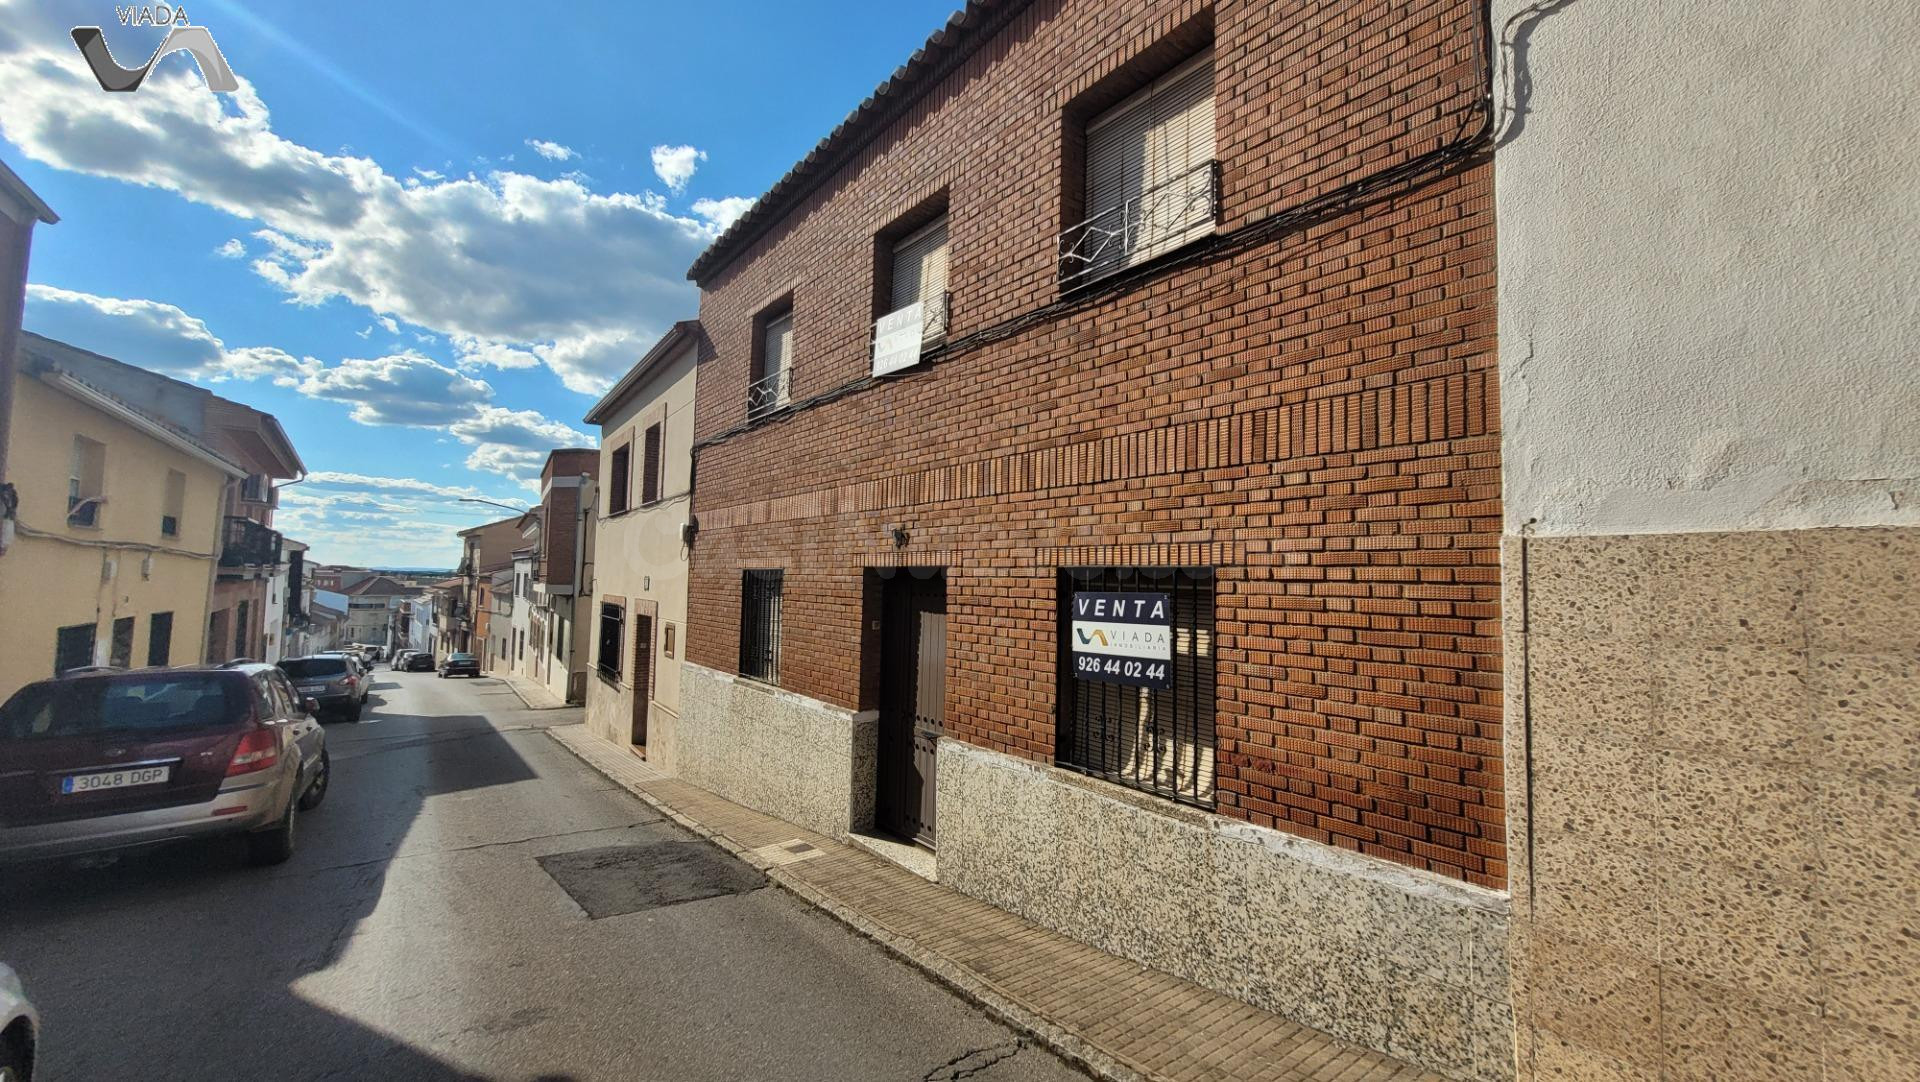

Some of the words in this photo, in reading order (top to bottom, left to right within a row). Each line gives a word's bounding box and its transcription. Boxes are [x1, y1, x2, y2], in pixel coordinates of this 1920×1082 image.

[1078, 598, 1164, 619] VENTA
[1110, 629, 1165, 643] VIADA
[1078, 656, 1101, 673] 926
[1104, 659, 1120, 675] 44
[1124, 660, 1141, 677] 02
[1146, 663, 1164, 680] 44
[78, 774, 123, 790] 3048
[130, 769, 162, 784] DGP
